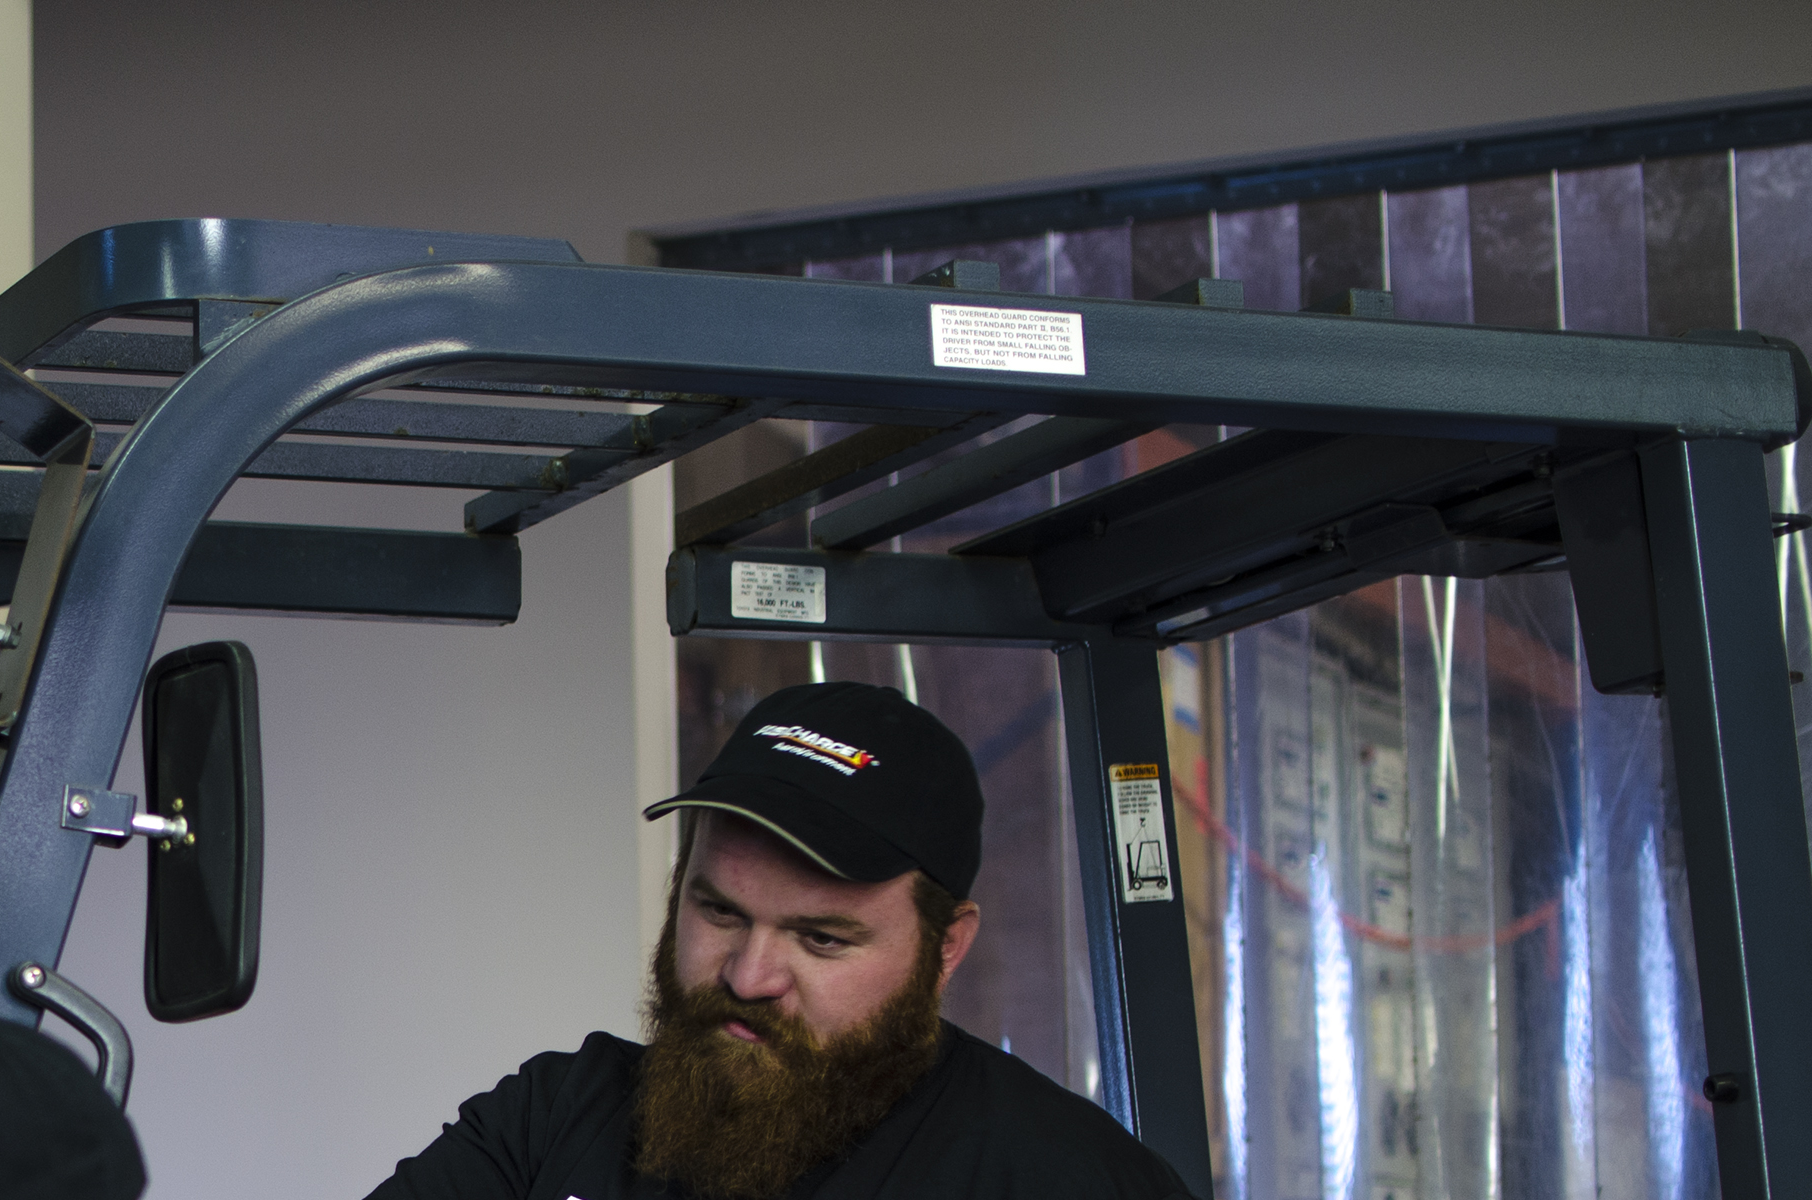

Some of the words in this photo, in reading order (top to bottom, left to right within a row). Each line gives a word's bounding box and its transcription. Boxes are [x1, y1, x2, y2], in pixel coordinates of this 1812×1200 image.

[940, 308, 957, 316] THIS
[959, 310, 1000, 319] OVERHEAD
[1001, 313, 1028, 321] GUARD
[1029, 315, 1070, 324] CONFORMS
[974, 321, 1016, 329] STANDARD
[1018, 323, 1038, 331] PART
[961, 329, 1001, 338] INTENDED
[1016, 333, 1054, 341] PROTECT
[1055, 335, 1070, 343] THE
[943, 337, 971, 345] DRIVER
[973, 339, 995, 347] FROM
[997, 340, 1023, 349] SMALL
[1025, 342, 1056, 352] FALLING
[944, 356, 979, 365] CAPACITY
[981, 358, 1007, 367] LOADS.
[974, 348, 990, 356] BUT
[993, 350, 1010, 358] NOT
[1012, 351, 1036, 359] FROM
[1039, 353, 1073, 362] FALLING
[1123, 766, 1156, 777] WARNING
